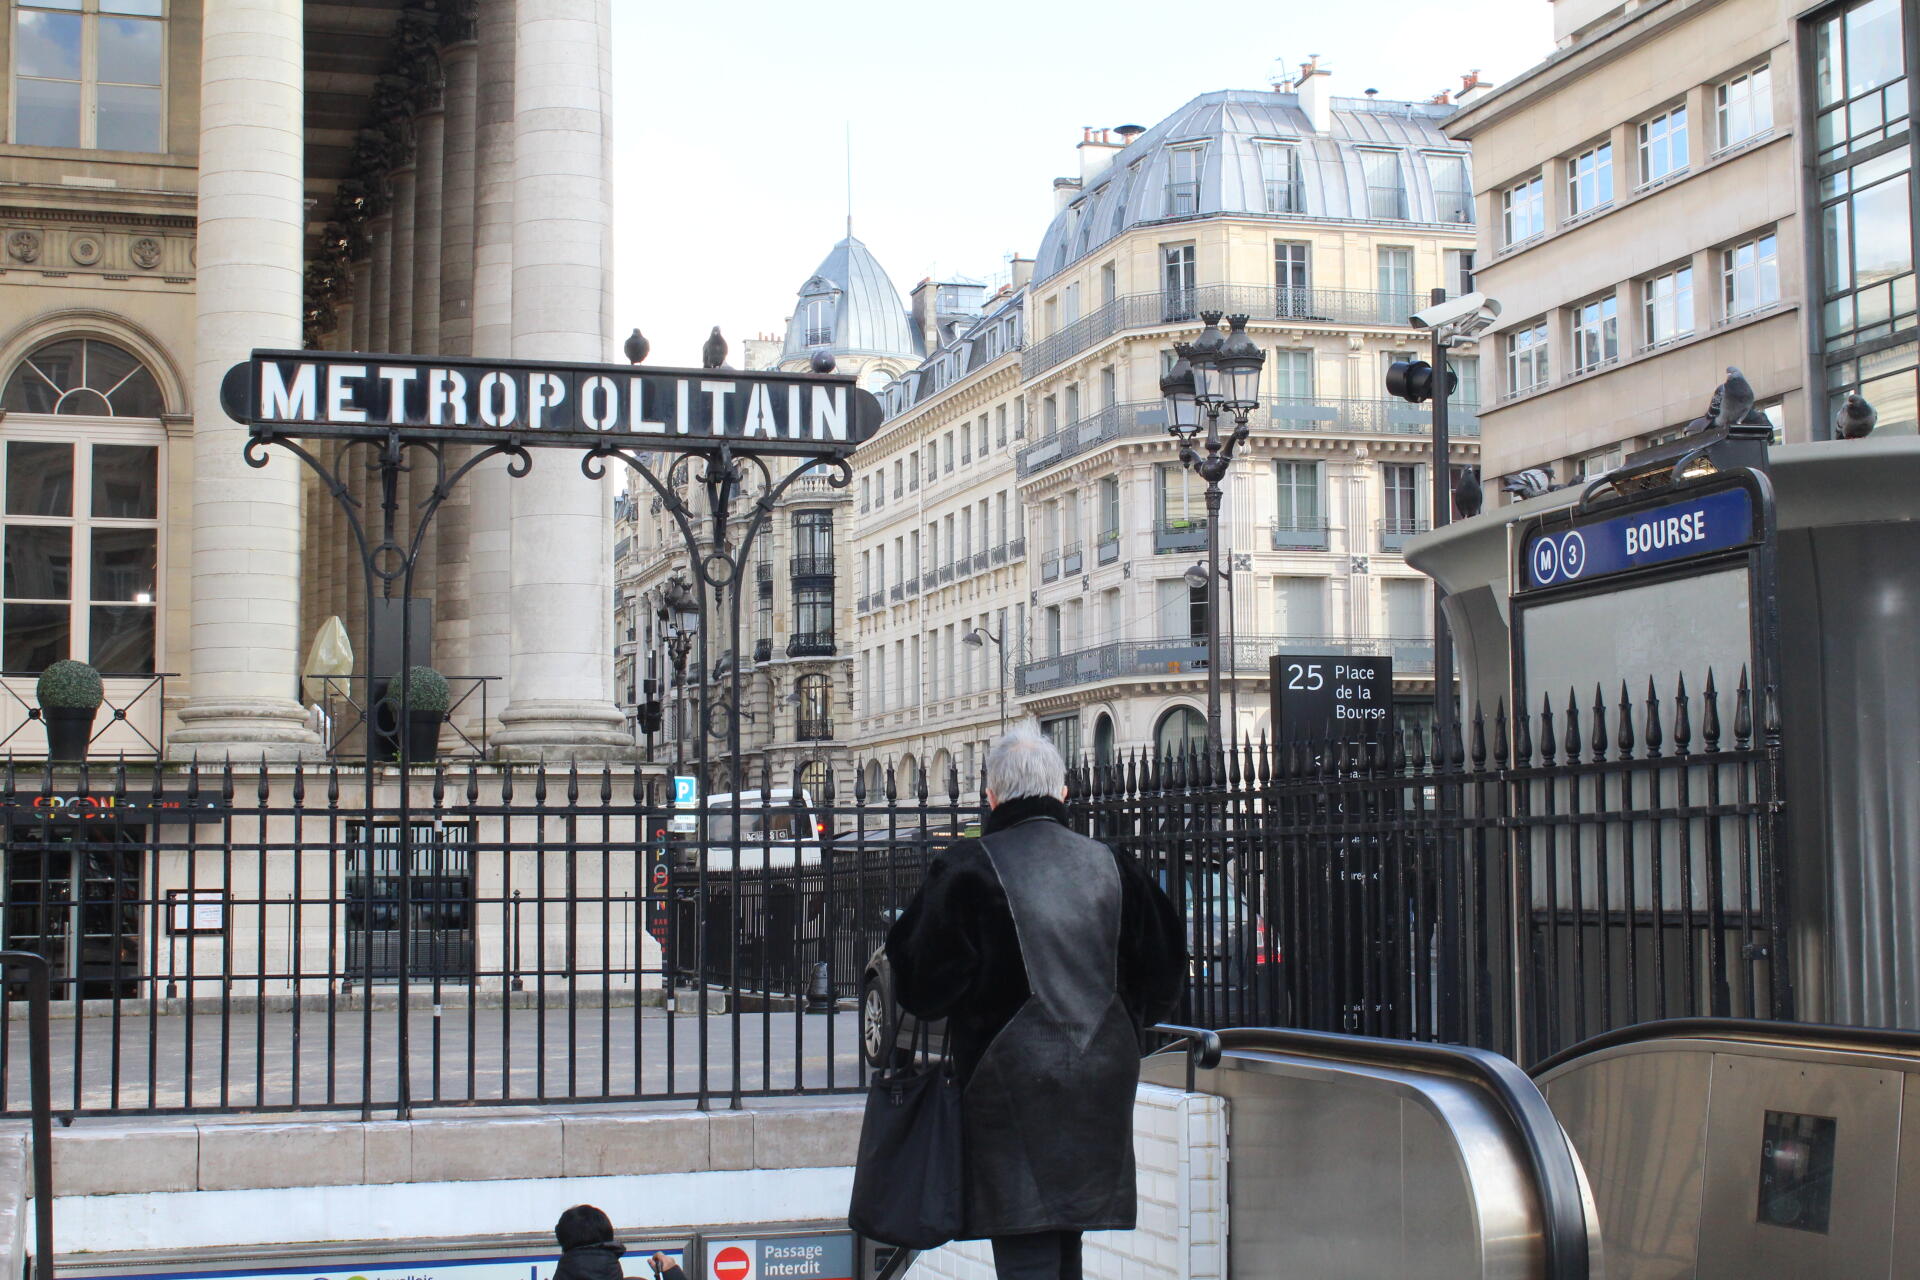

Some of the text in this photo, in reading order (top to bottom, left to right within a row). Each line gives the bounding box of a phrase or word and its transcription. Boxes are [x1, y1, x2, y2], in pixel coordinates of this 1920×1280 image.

[260, 361, 847, 441] METROPOLITAIN
[1626, 510, 1705, 556] BOURSE
[1288, 664, 1375, 690] 25 Place
[1336, 684, 1371, 699] de la
[1336, 704, 1386, 719] Bourse
[678, 782, 690, 799] P
[765, 1244, 822, 1259] Passage
[765, 1260, 820, 1276] interdit
